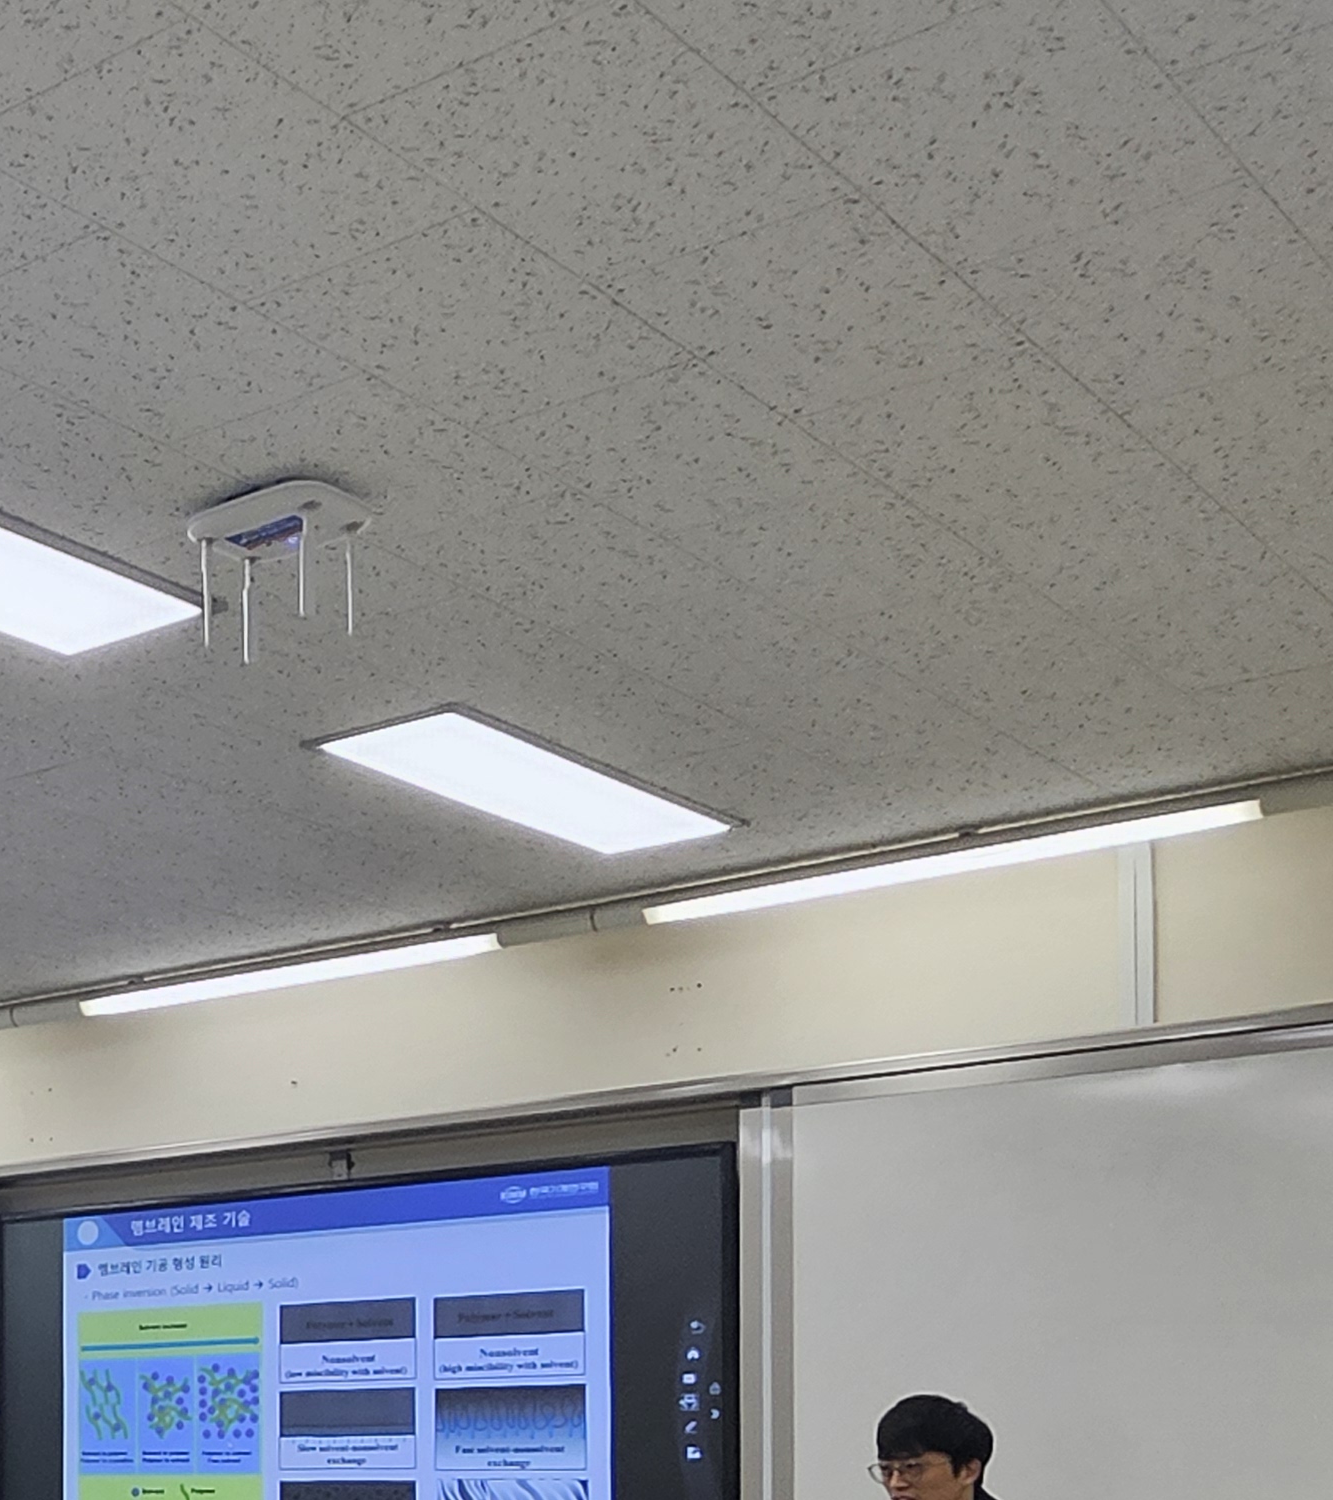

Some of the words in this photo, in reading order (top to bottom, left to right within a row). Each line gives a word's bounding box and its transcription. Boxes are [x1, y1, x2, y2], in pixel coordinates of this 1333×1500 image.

[189, 1213, 217, 1231] 제조
[223, 1209, 251, 1228] 기술
[145, 1258, 168, 1272] 기공
[199, 1254, 222, 1269] 원리
[92, 1290, 119, 1301] Phase
[123, 1287, 167, 1299] inversion
[217, 1280, 250, 1294] Liquid
